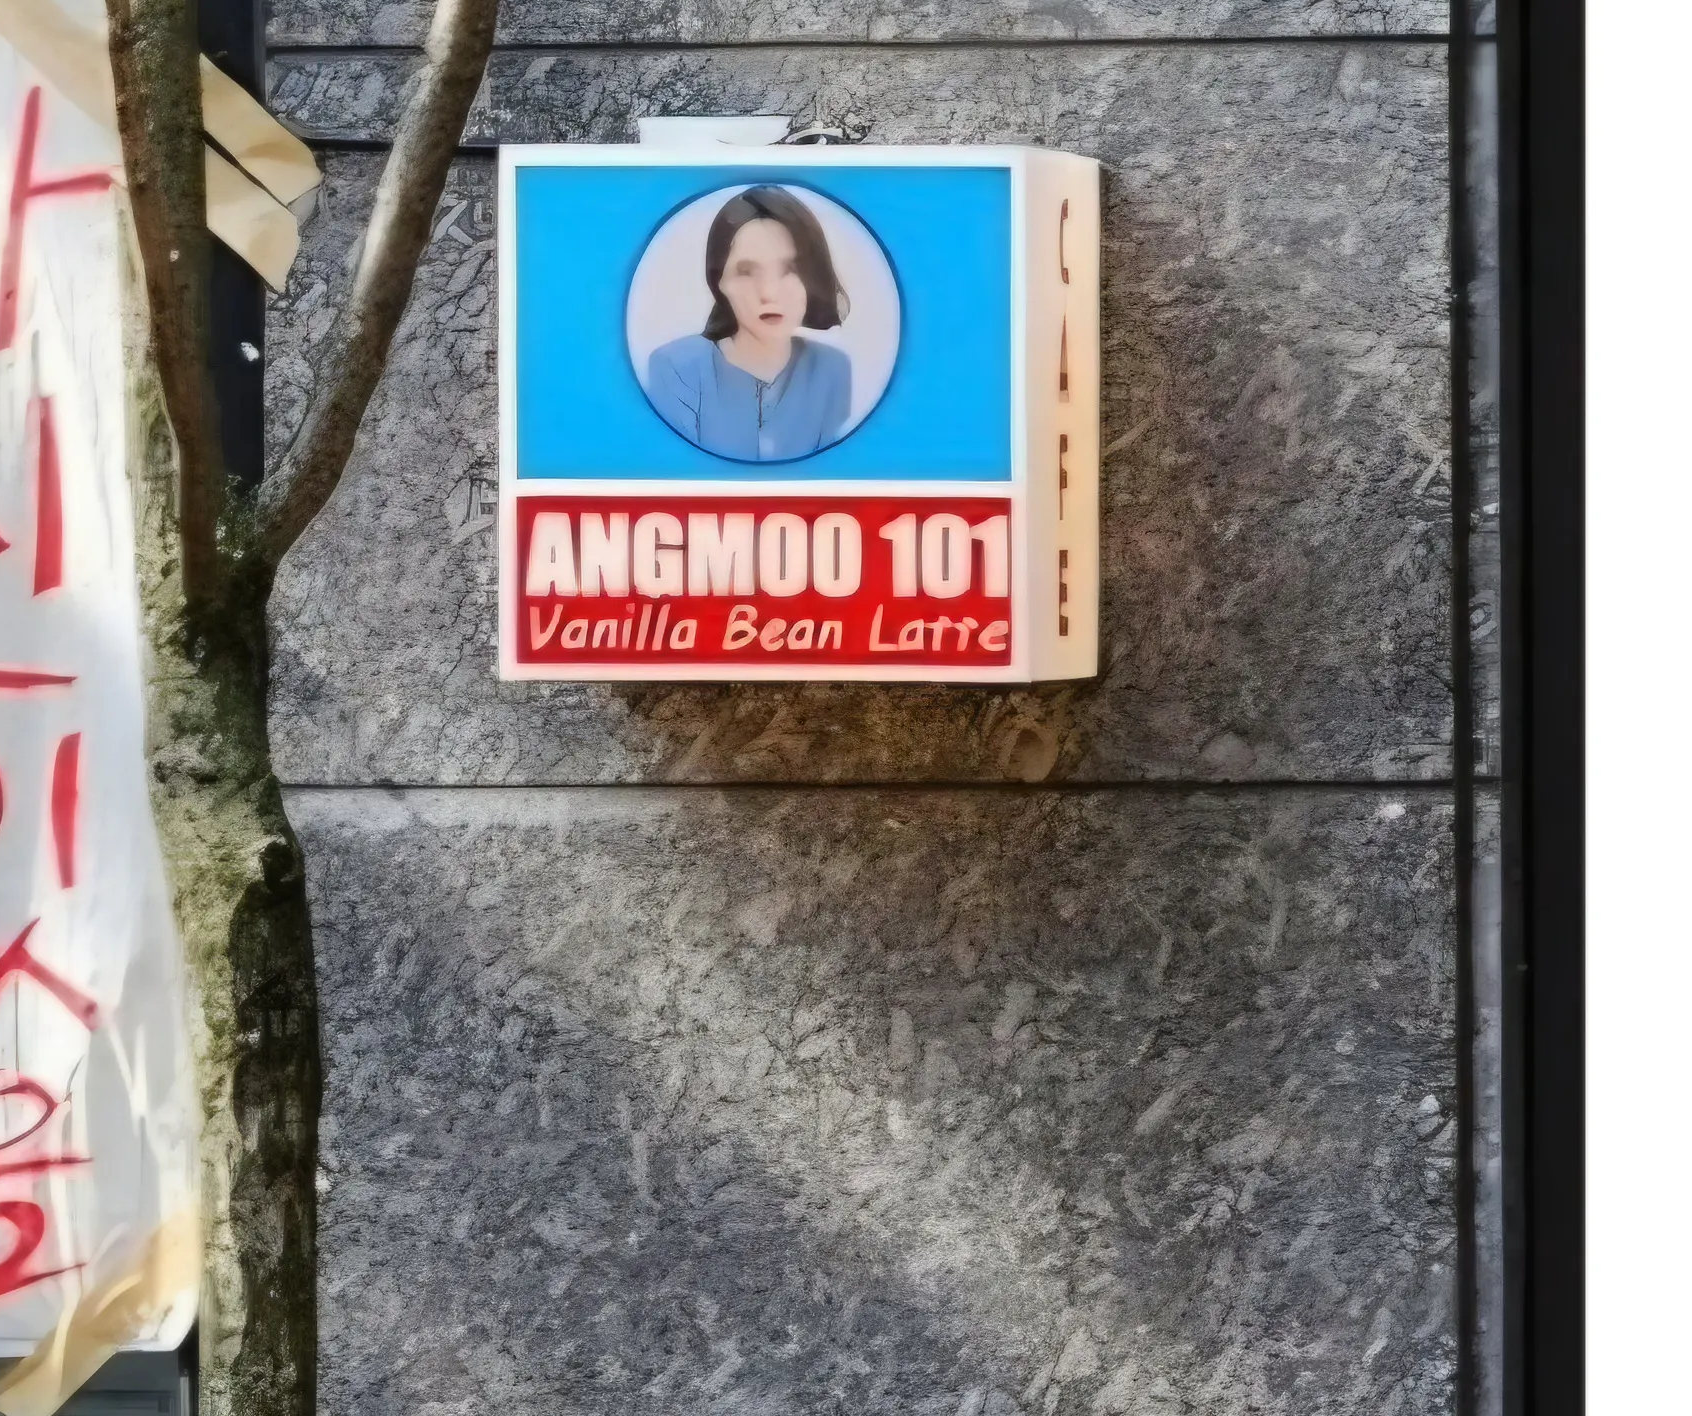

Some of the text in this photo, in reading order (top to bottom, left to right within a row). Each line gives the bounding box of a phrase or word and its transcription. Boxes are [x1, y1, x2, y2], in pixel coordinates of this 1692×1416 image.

[525, 511, 1008, 598] ANGMOO 101
[529, 602, 1008, 652] Vanilla Bean Latte
